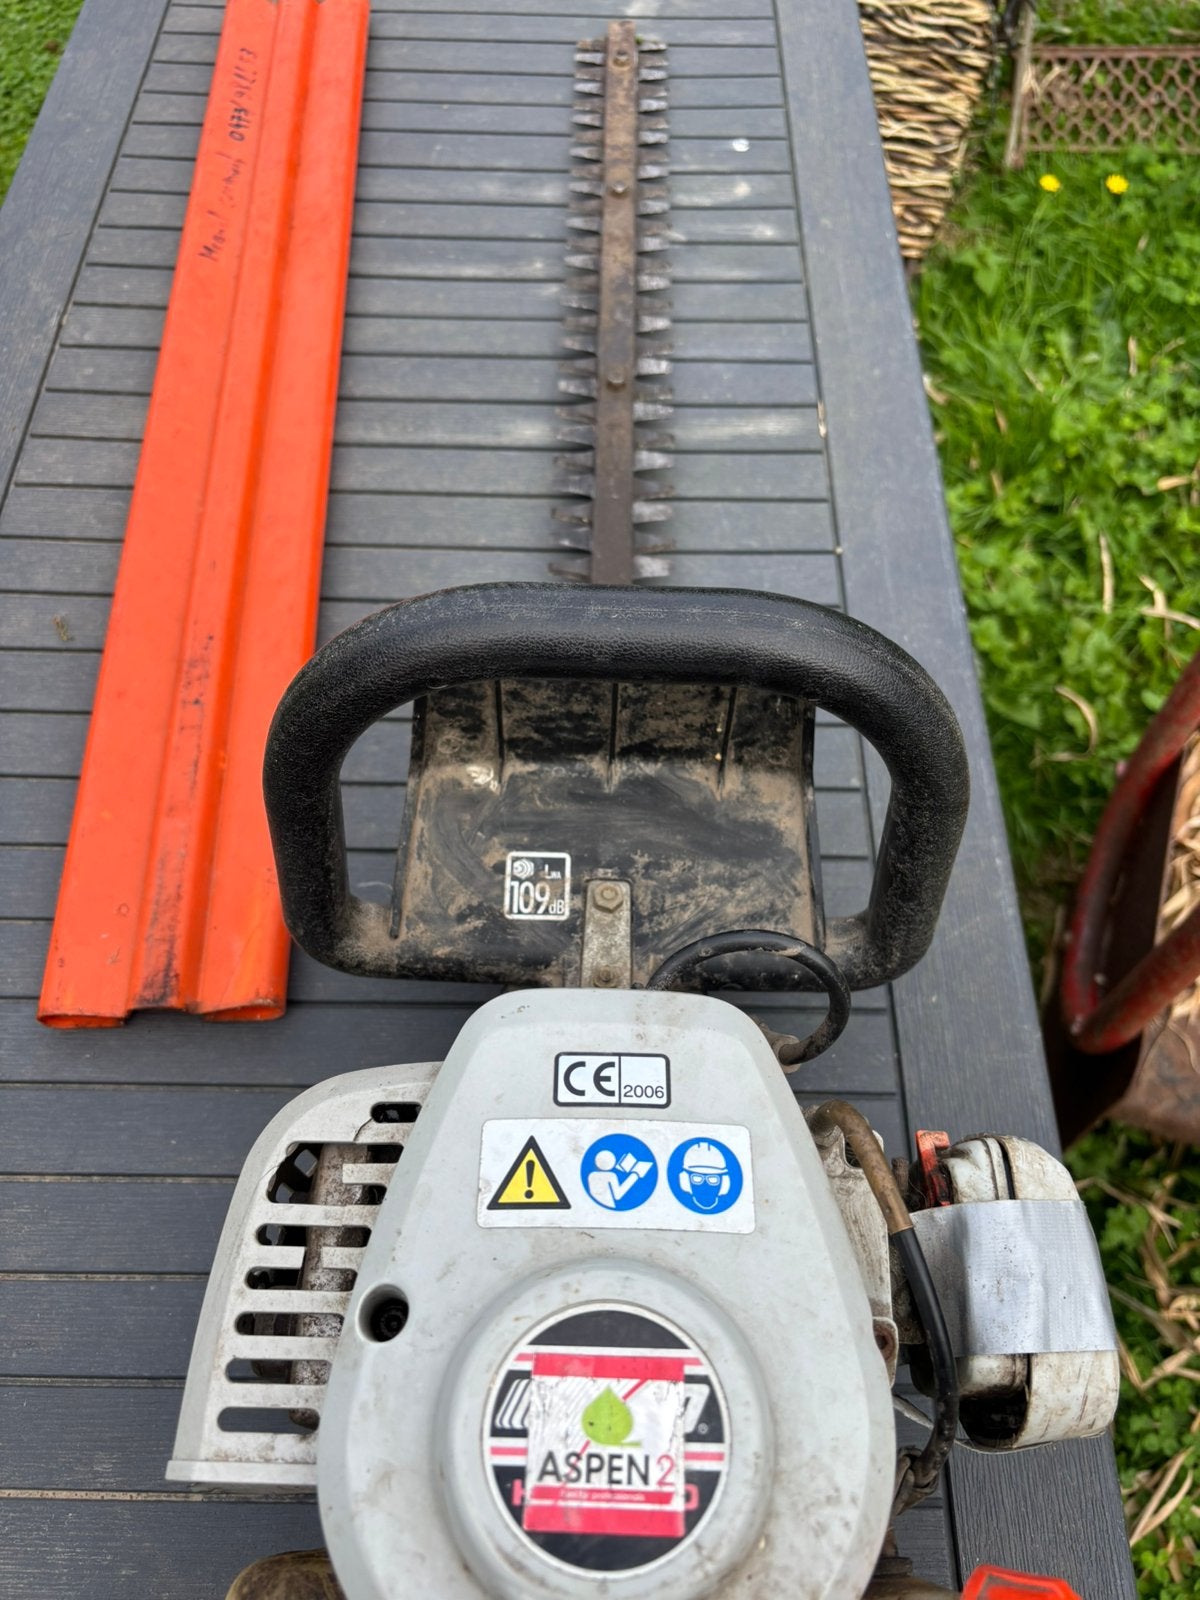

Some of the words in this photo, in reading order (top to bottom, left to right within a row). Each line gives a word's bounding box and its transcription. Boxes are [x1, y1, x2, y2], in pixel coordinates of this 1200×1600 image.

[510, 880, 550, 914] 109
[548, 898, 565, 914] dB
[563, 1060, 616, 1097] CE
[622, 1083, 665, 1099] 2006
[537, 1450, 650, 1486] ASPEN
[656, 1453, 676, 1487] 2
